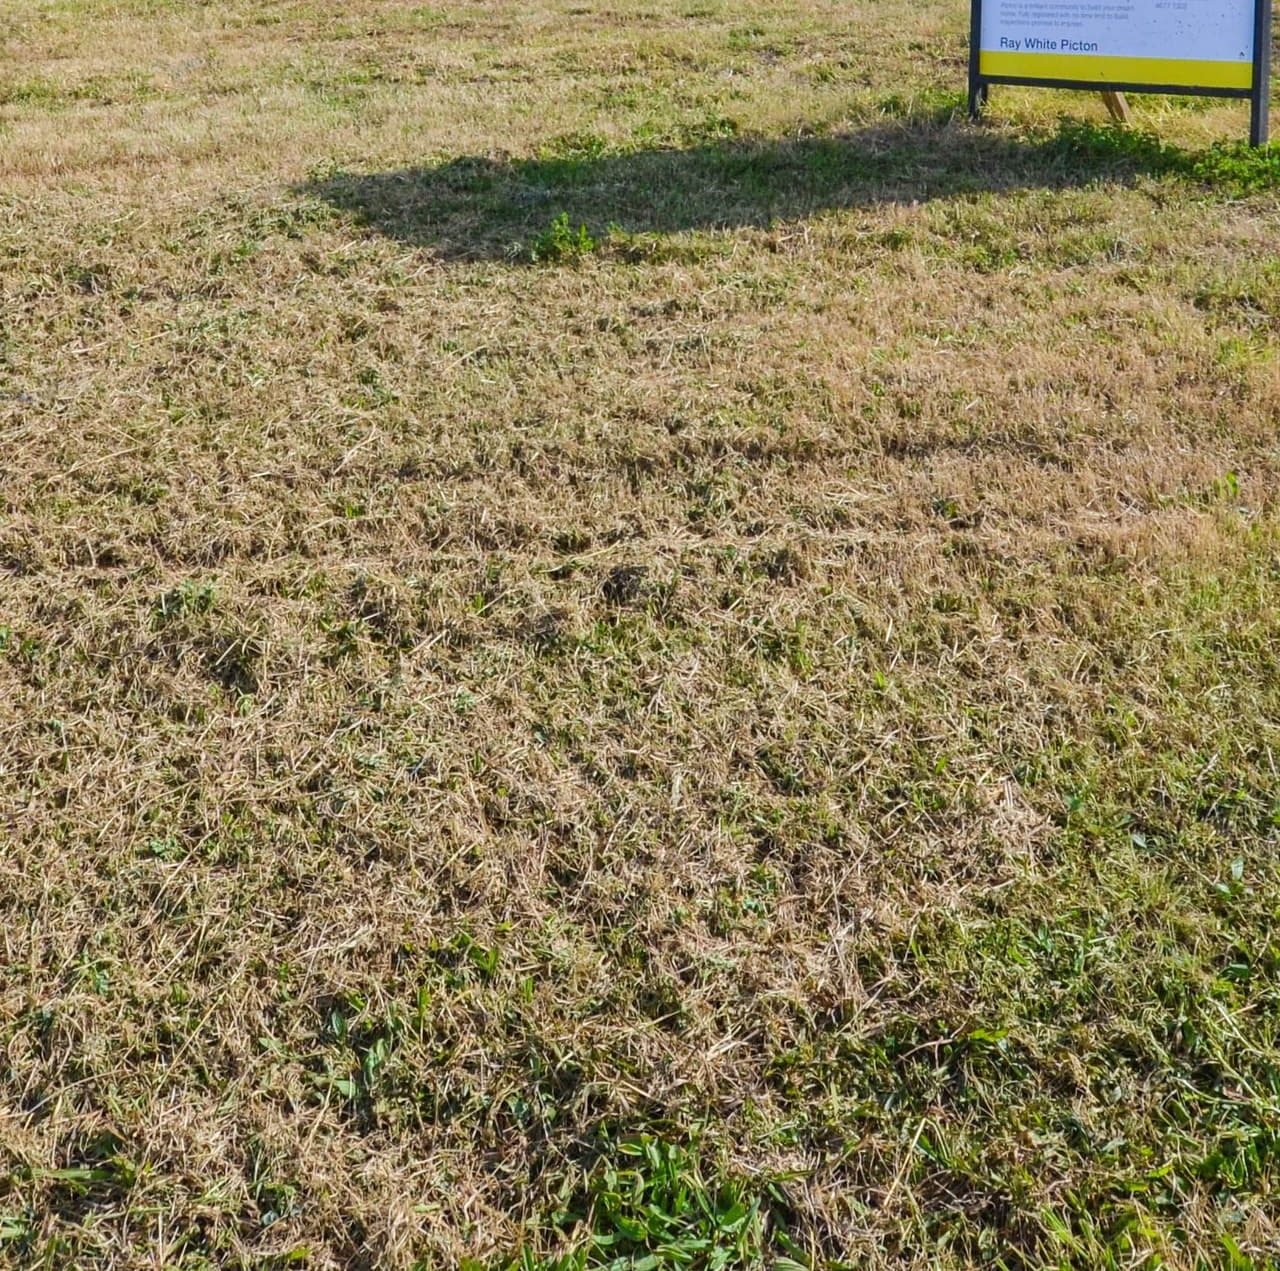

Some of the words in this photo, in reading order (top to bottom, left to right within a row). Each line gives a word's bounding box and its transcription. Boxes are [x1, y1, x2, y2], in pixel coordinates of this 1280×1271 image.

[1000, 36, 1021, 51] Ray
[1024, 37, 1057, 50] White
[1060, 39, 1098, 51] Picton
